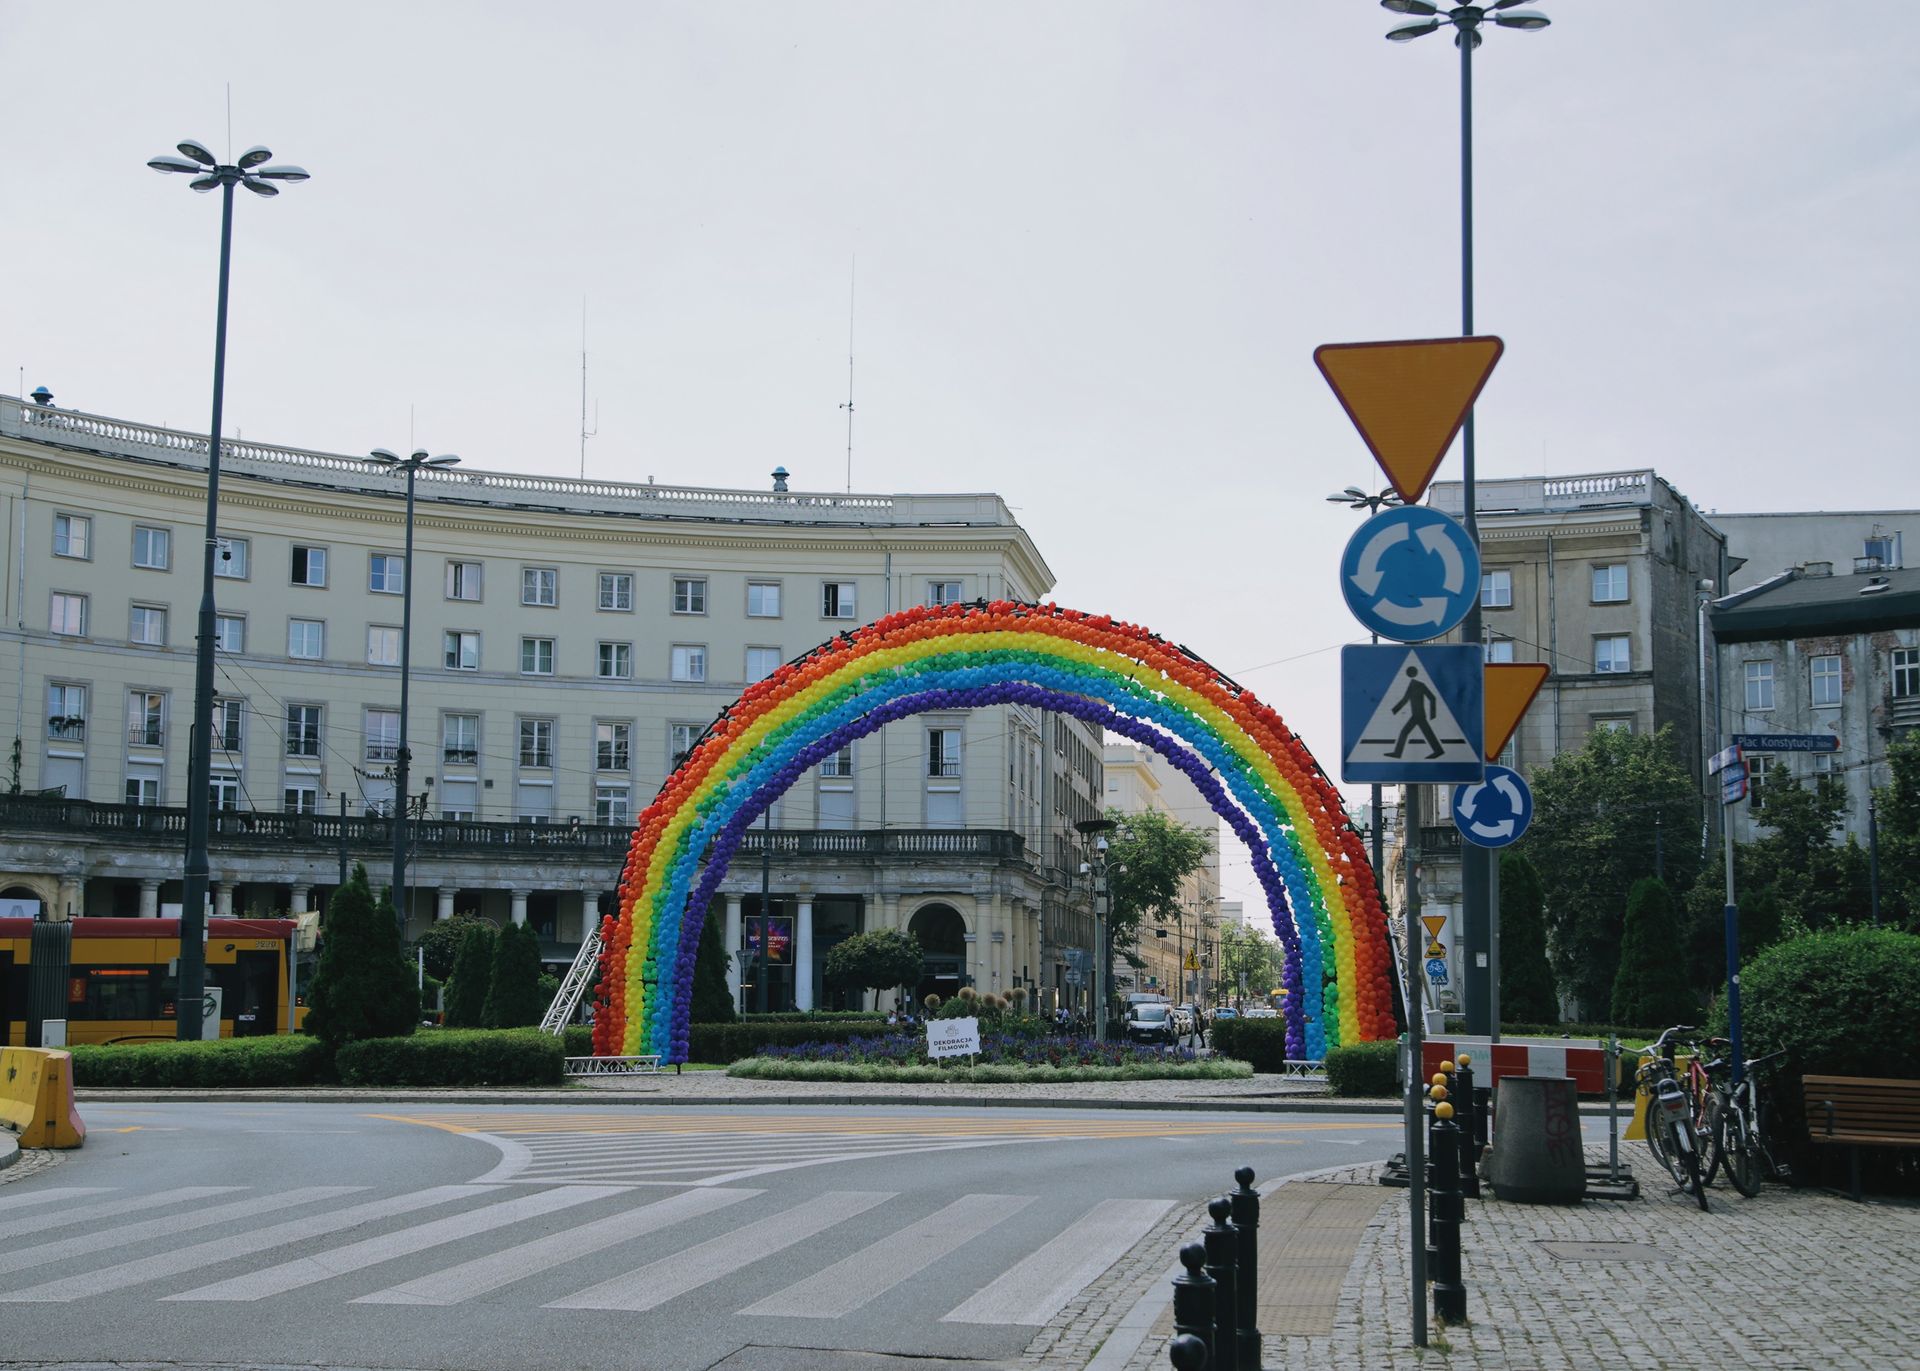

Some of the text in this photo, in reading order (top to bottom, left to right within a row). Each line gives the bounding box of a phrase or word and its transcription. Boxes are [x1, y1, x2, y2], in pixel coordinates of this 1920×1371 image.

[1738, 737, 1758, 747] Plac
[1761, 737, 1814, 750] Konstytucji
[933, 1037, 972, 1046] DEKORACJA
[938, 1043, 969, 1051] FILMOWA
